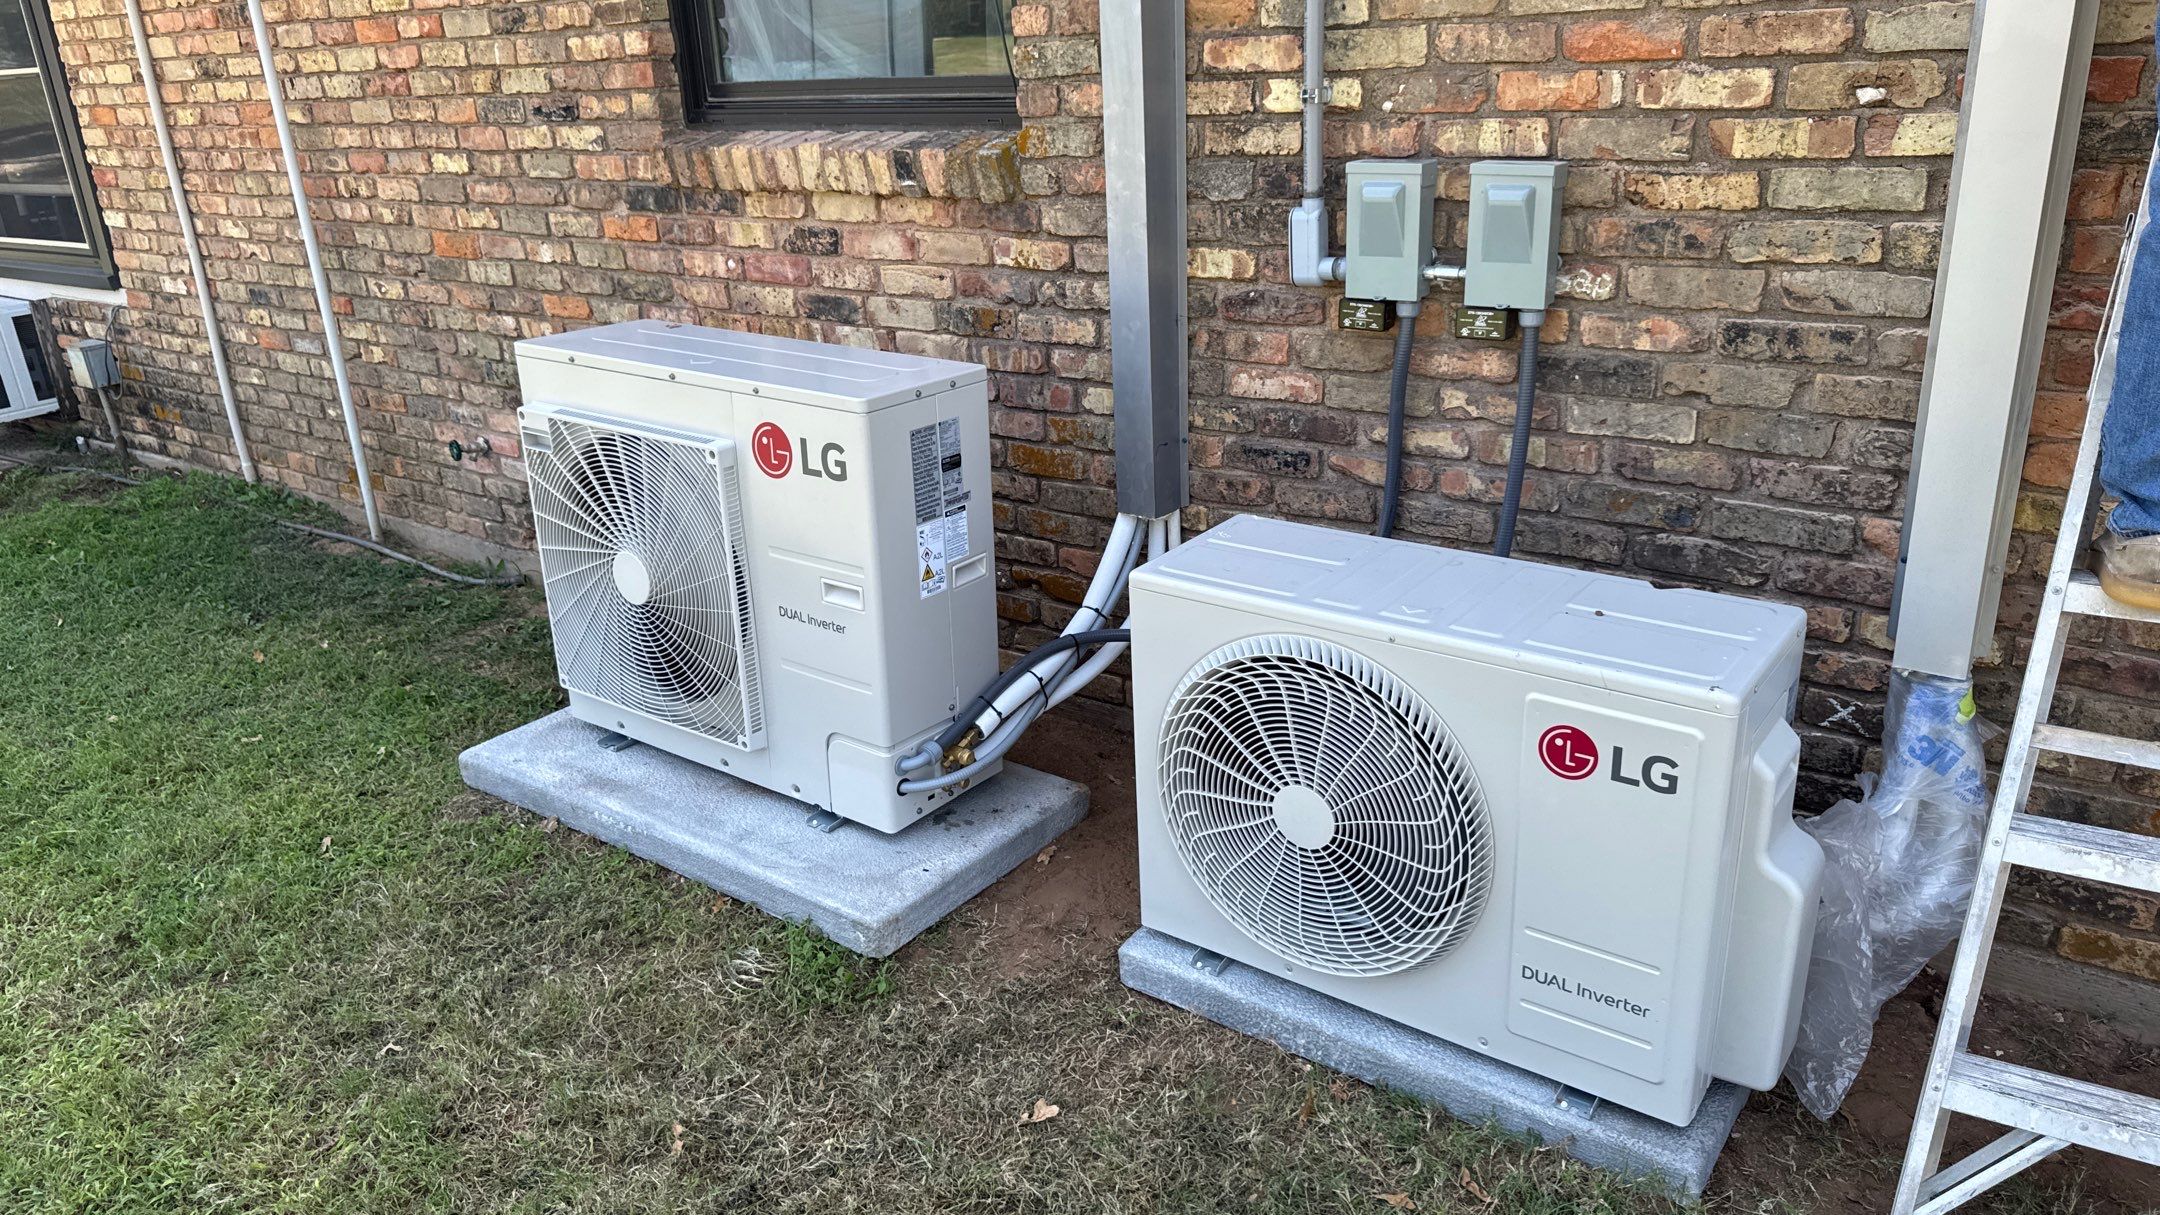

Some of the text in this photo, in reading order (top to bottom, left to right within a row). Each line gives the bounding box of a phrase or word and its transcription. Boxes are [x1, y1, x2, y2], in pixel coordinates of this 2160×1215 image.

[800, 437, 847, 481] LG
[779, 606, 846, 634] DUAL Inverter
[1611, 746, 1679, 794] LG
[1522, 965, 1650, 1017] DUAL Inverter
